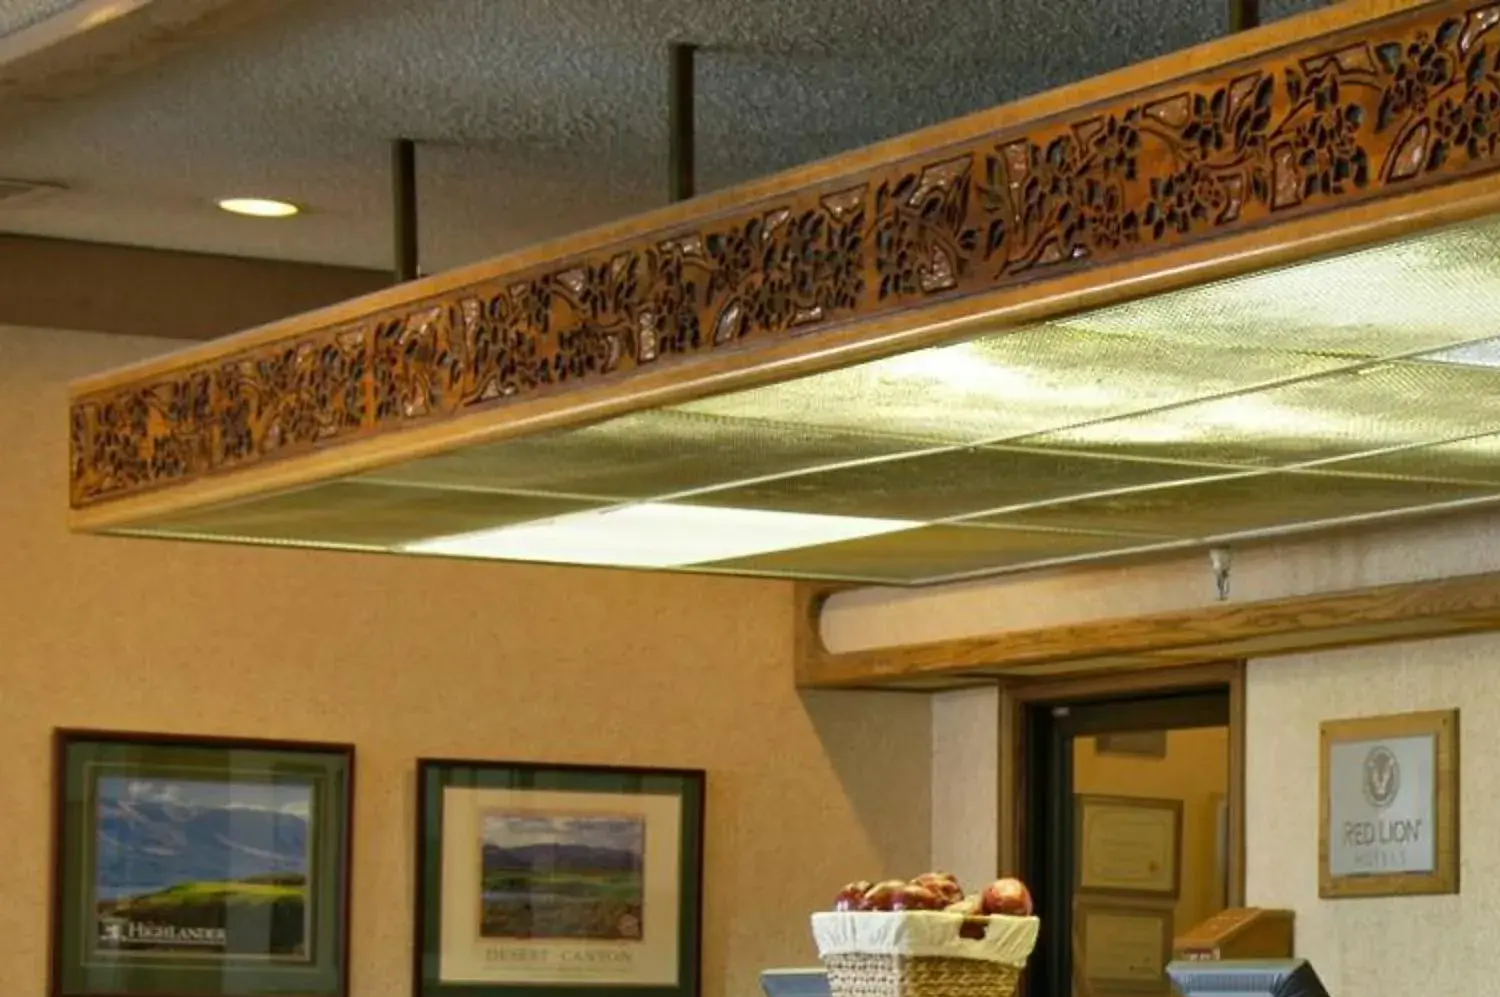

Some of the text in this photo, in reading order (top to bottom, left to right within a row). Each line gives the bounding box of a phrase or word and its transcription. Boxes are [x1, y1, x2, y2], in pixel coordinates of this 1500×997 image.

[1343, 819, 1422, 846] RED LION
[485, 947, 633, 963] DESERT CANYON
